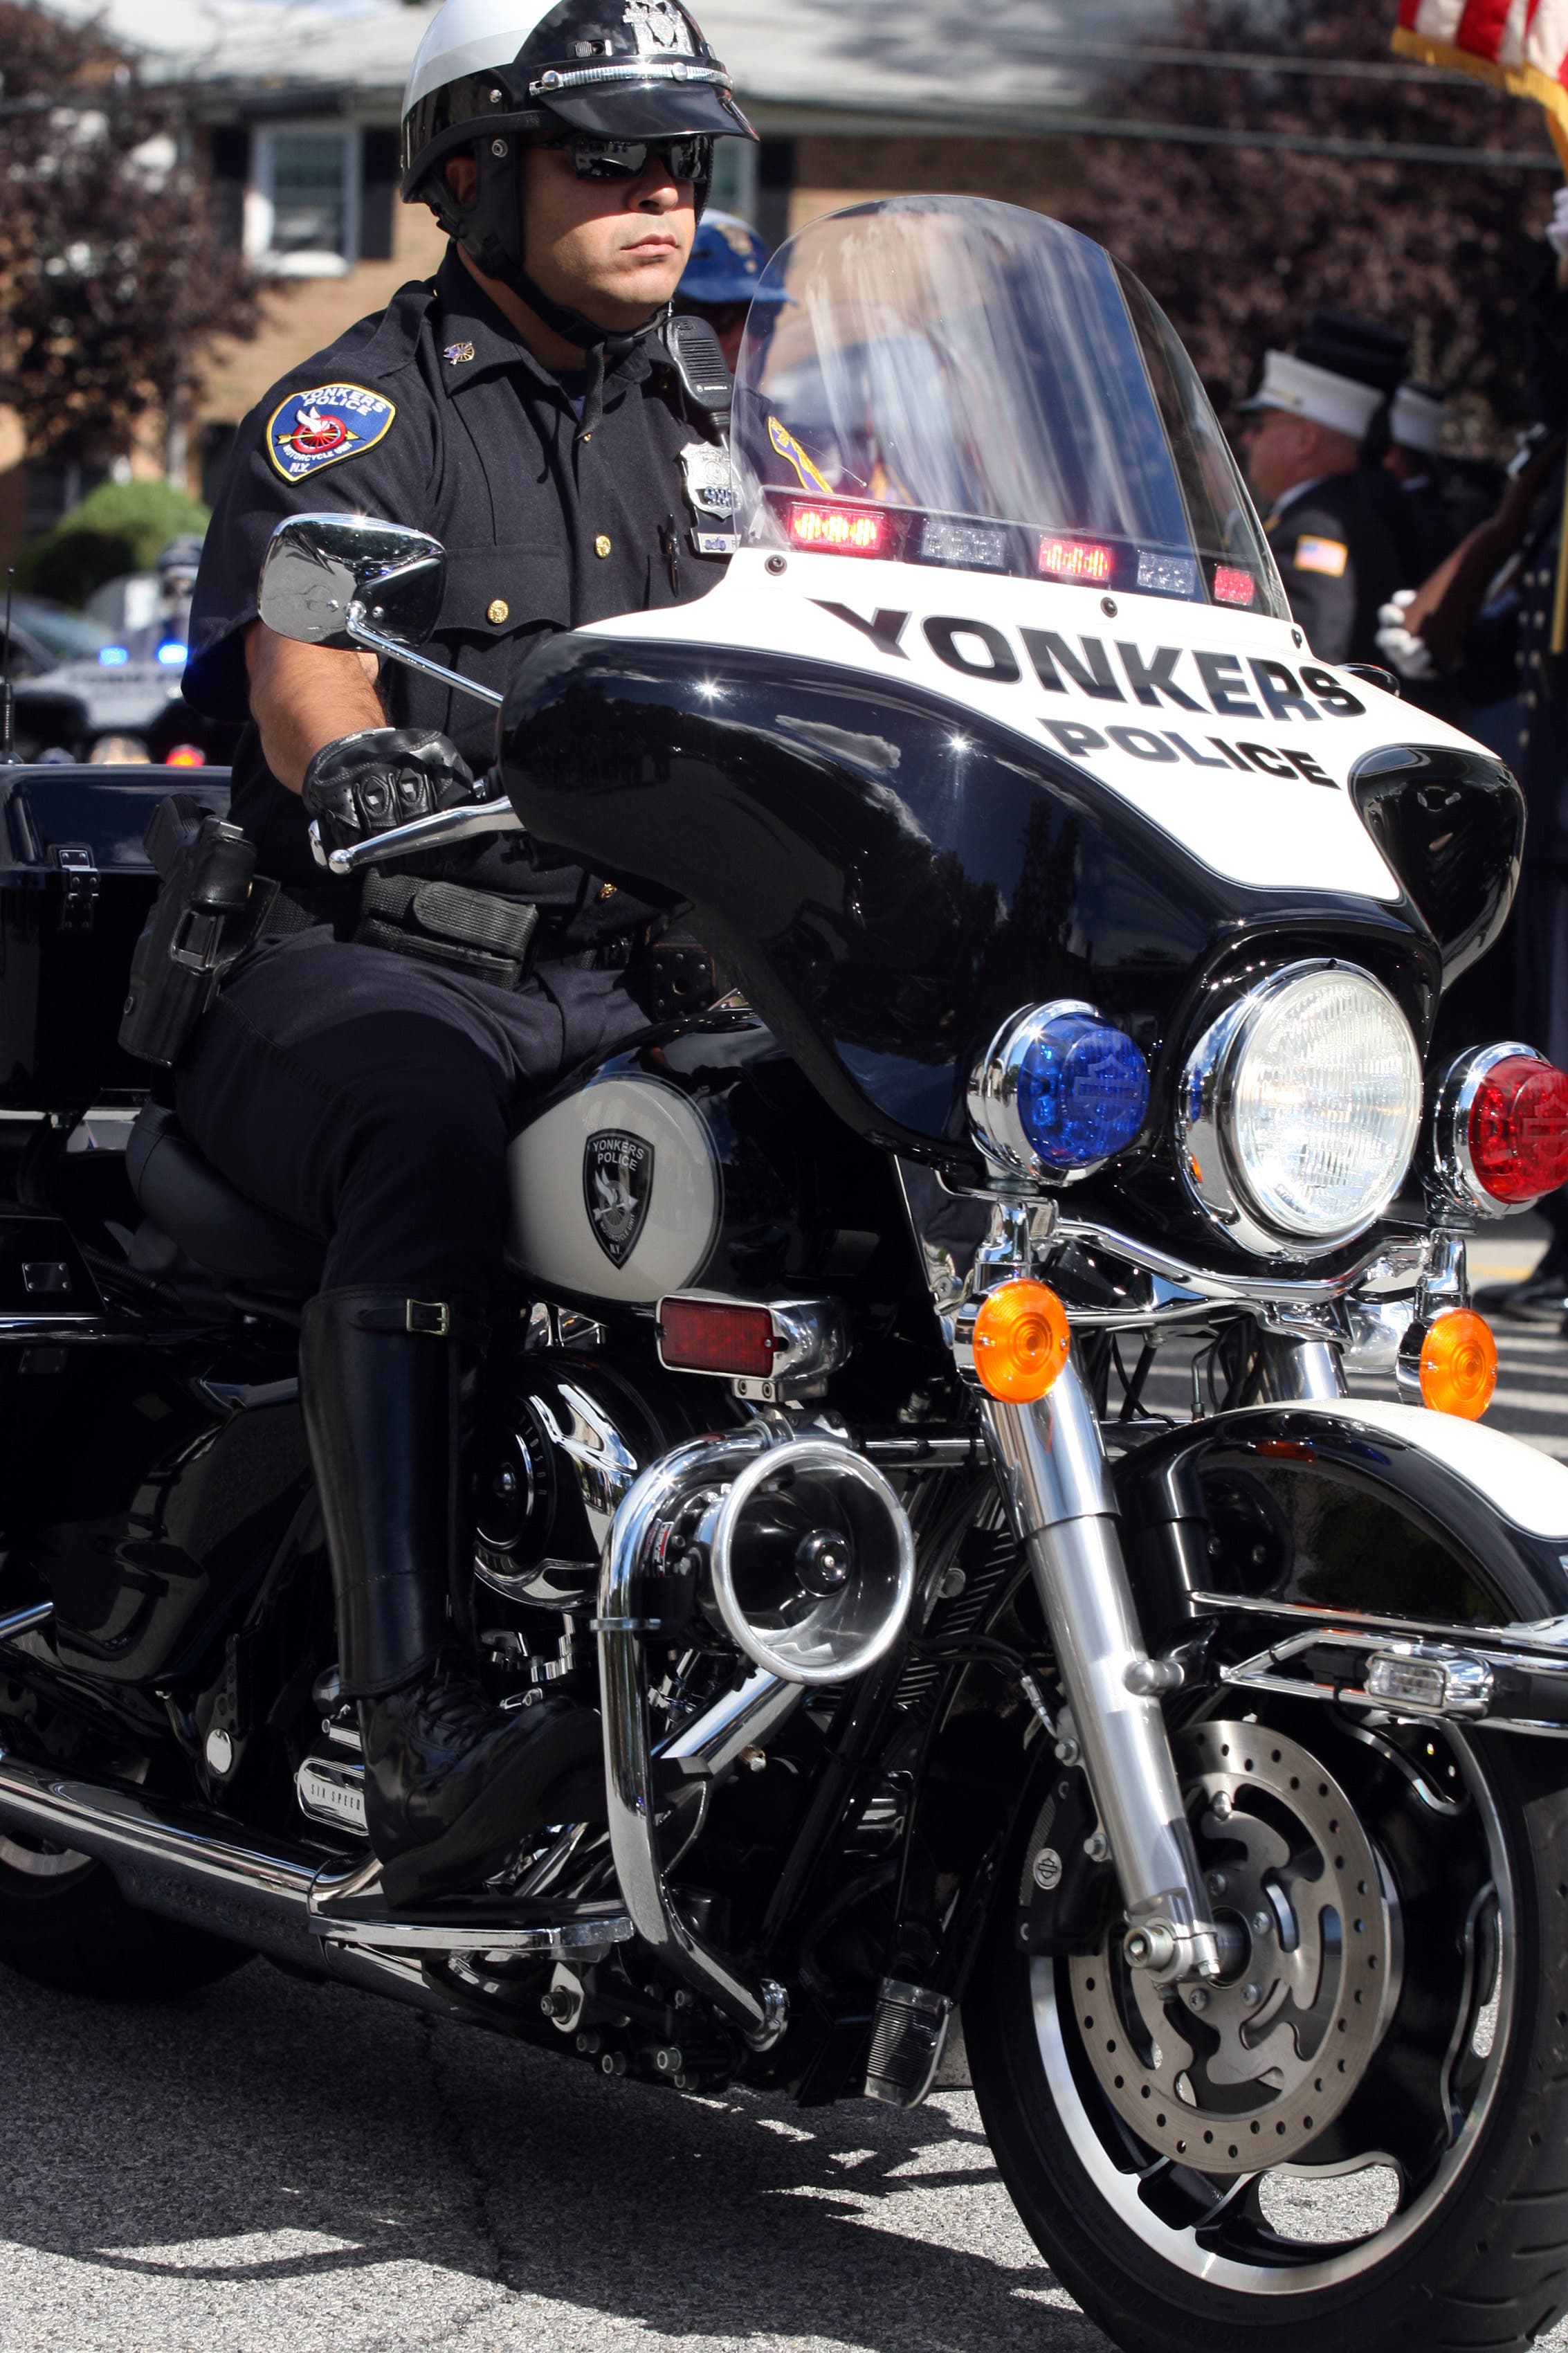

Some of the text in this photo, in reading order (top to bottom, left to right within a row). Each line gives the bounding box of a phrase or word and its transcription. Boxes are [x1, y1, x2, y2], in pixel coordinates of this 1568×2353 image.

[300, 388, 387, 413] YONKERS
[302, 396, 372, 416] POLICE
[282, 441, 353, 462] MOTORCYCLE UNIT
[804, 597, 1367, 723] YONKERS
[1037, 717, 1342, 790] POLICE
[593, 1140, 644, 1160] YONKERS
[598, 1154, 637, 1172] POLICE
[311, 1783, 361, 1810] SIX SPEED
